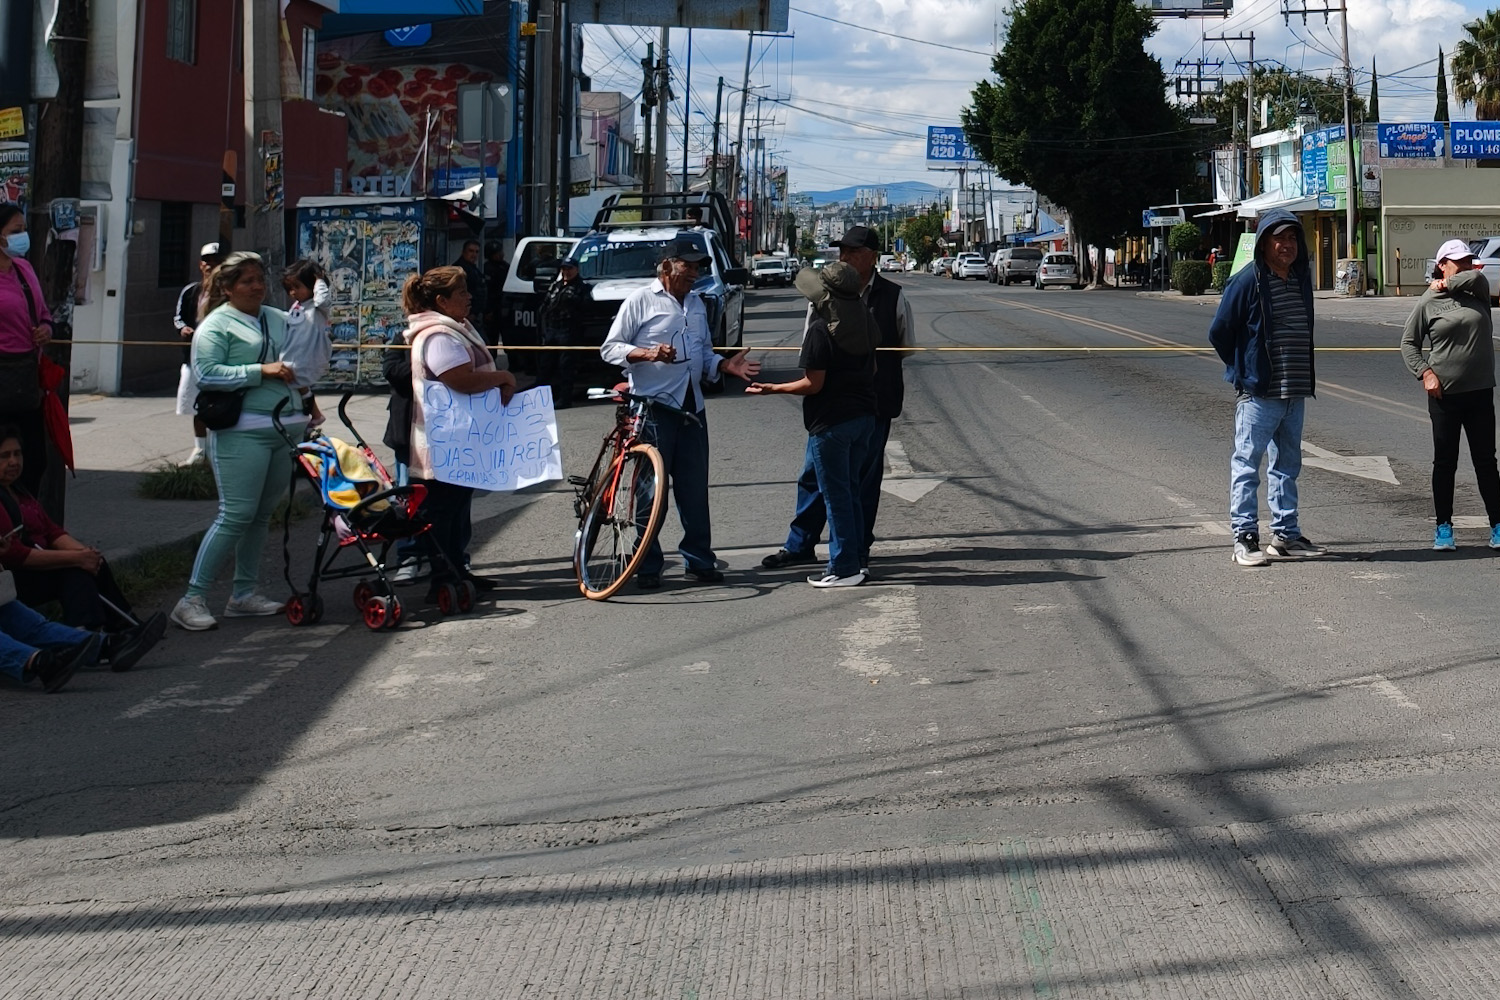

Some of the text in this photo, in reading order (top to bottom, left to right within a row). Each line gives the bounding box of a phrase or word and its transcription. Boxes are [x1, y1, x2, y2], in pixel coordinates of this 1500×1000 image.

[1397, 132, 1428, 143] Angel
[1453, 144, 1474, 155] 221
[1480, 144, 1500, 155] 146
[429, 415, 461, 444] EL
[467, 416, 519, 446] AGUA
[431, 447, 477, 468] DIAS
[510, 437, 554, 466] RED
